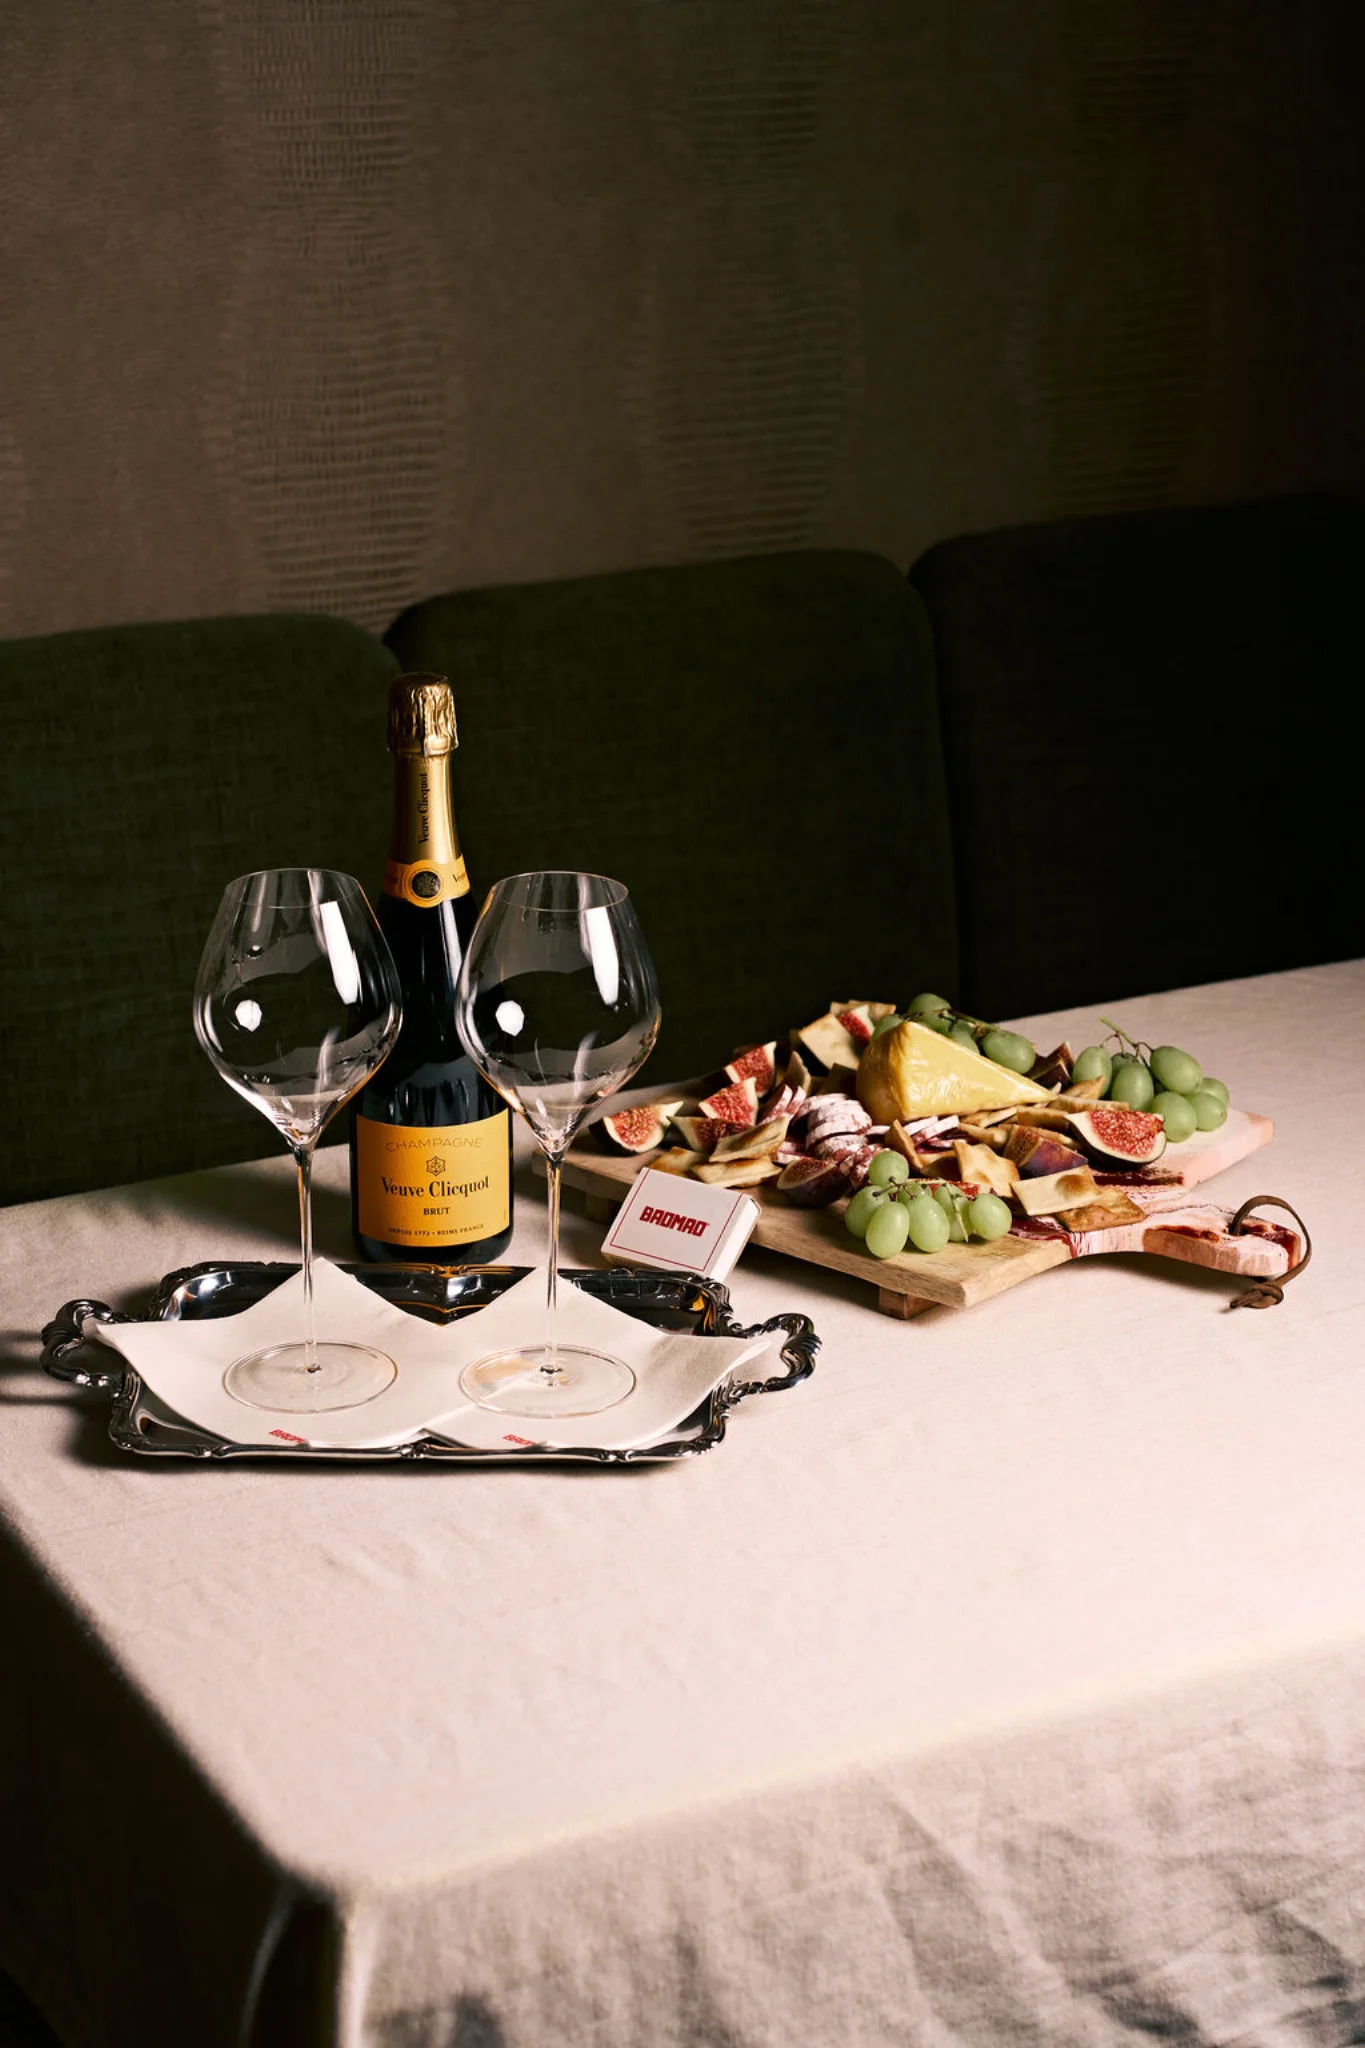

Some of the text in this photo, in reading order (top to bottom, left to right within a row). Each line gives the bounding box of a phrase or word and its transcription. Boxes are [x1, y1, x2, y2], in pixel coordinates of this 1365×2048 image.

[418, 773, 431, 844] Veuve Clicquot
[386, 1136, 483, 1152] CHAMPAGNE
[381, 1176, 490, 1198] Veuve Clicquot
[423, 1207, 450, 1216] BRUT
[459, 1223, 485, 1234] FRANCE
